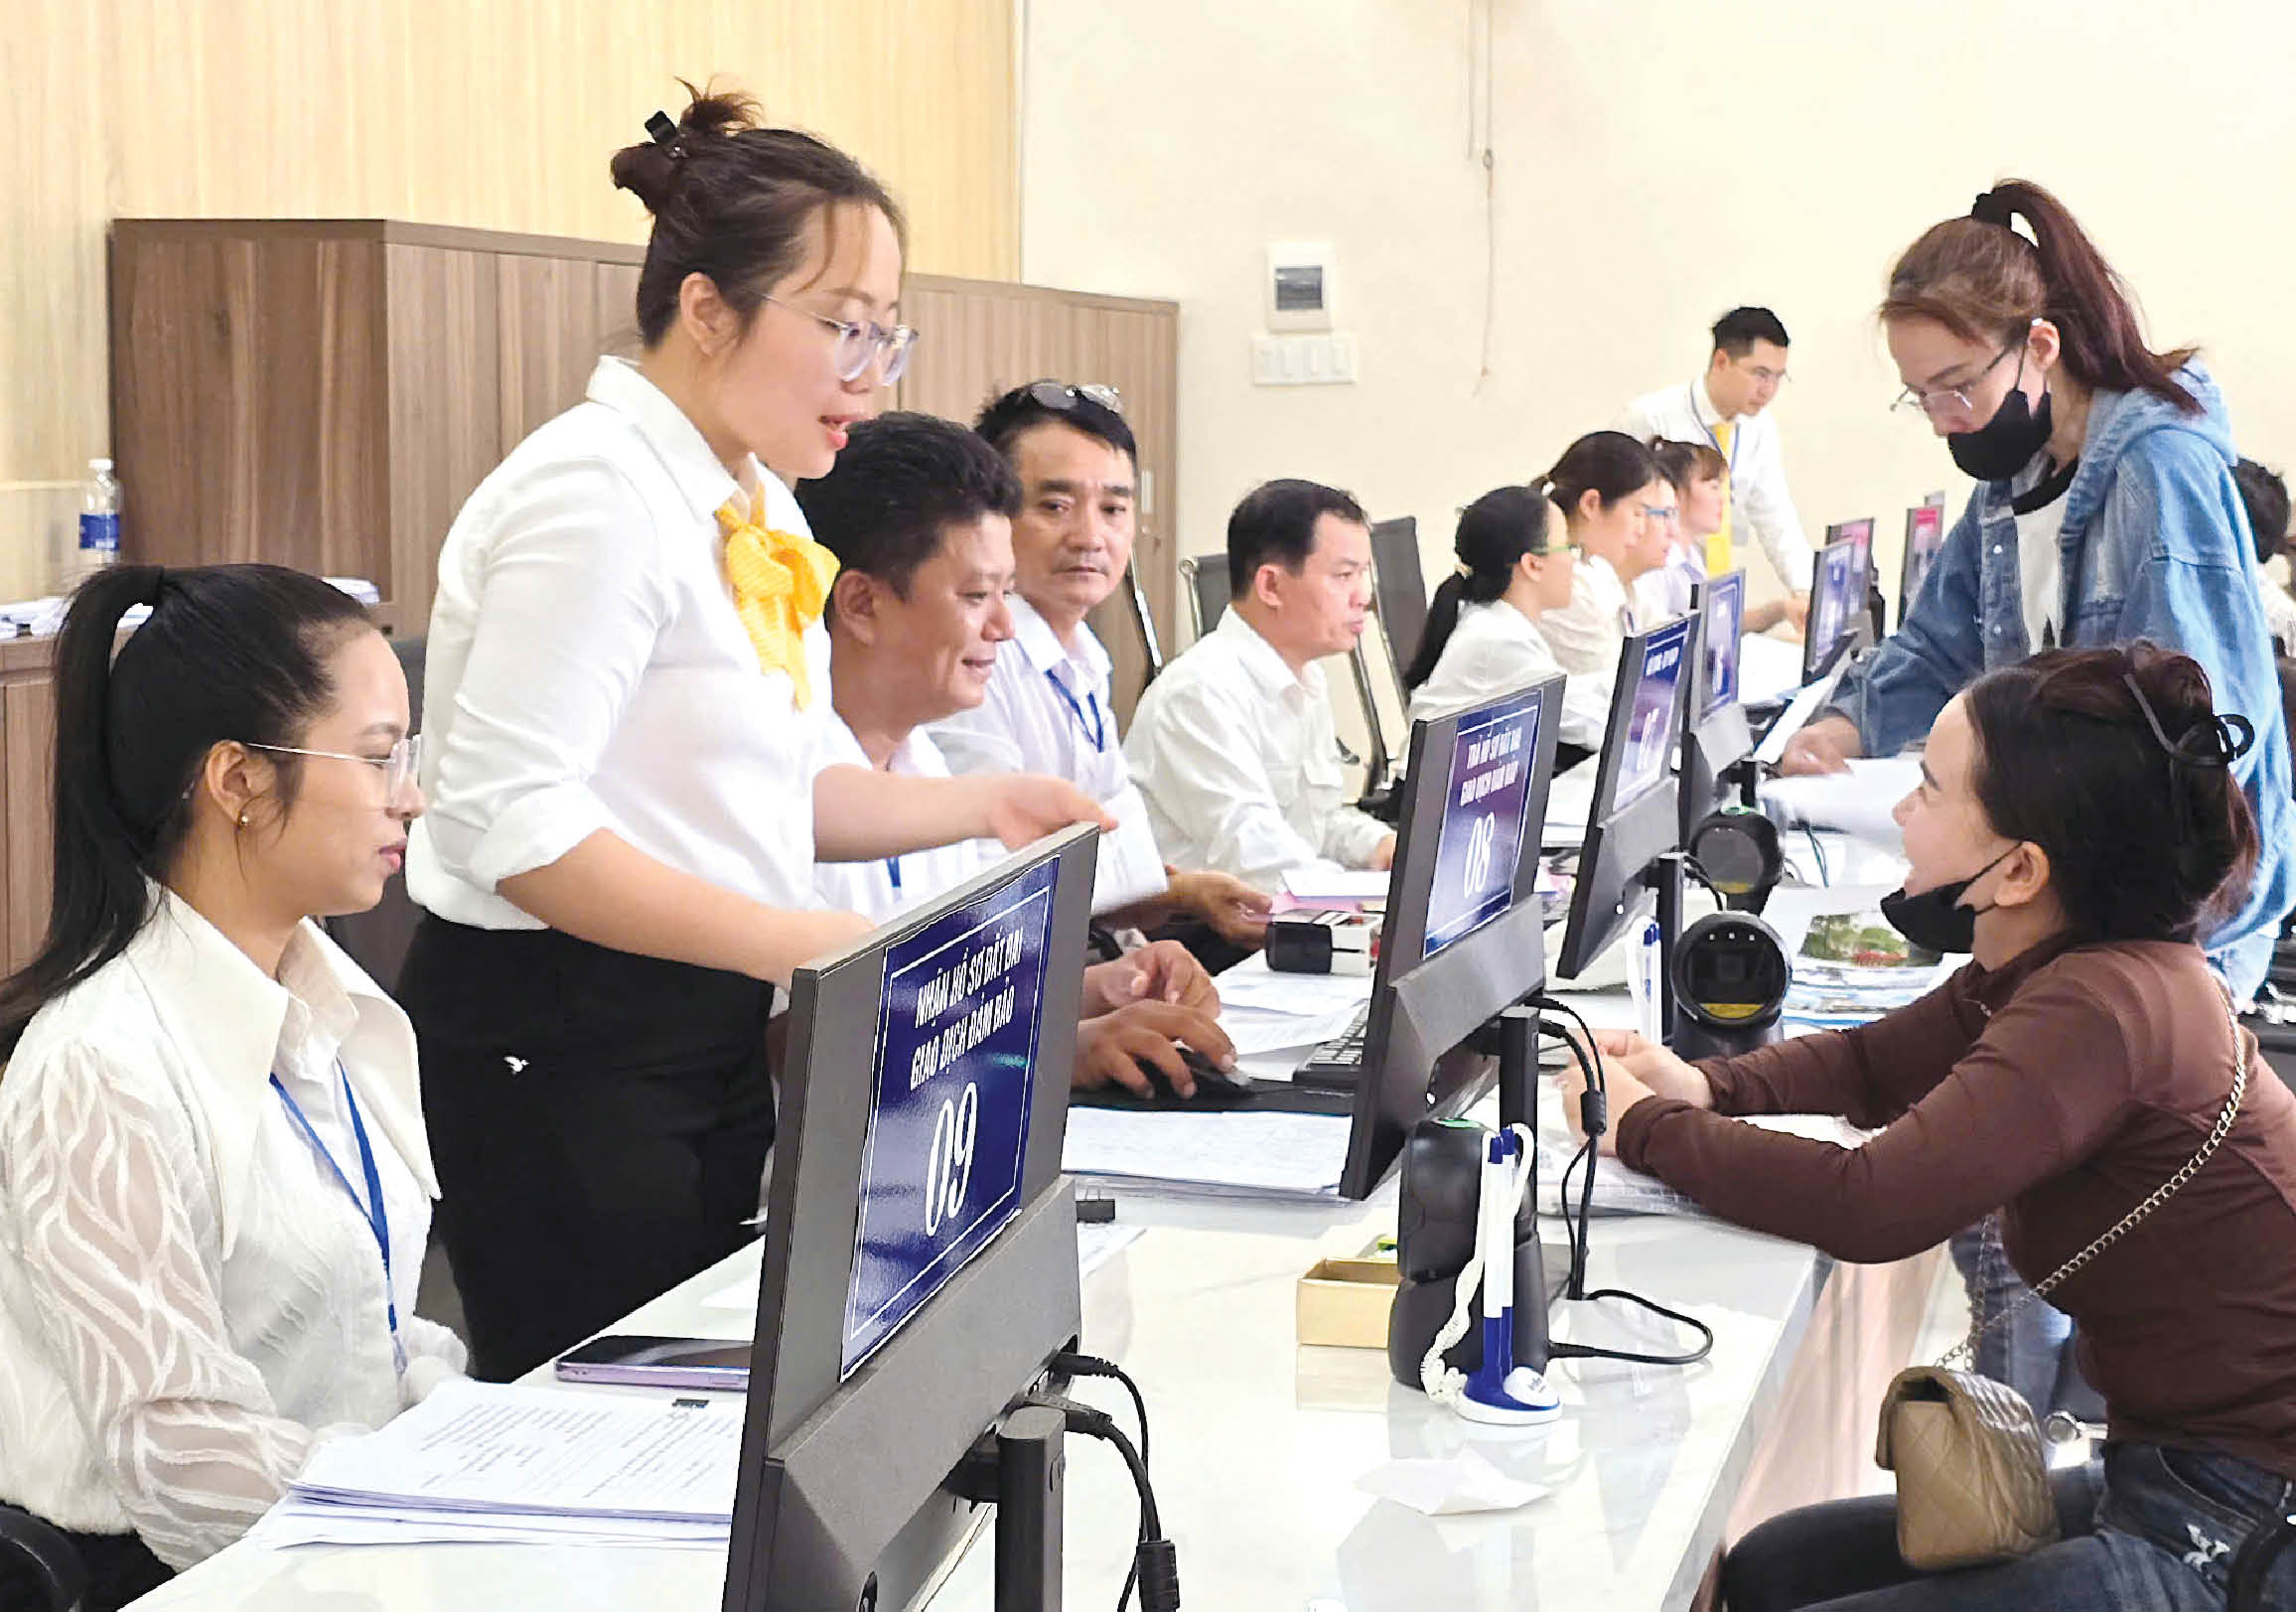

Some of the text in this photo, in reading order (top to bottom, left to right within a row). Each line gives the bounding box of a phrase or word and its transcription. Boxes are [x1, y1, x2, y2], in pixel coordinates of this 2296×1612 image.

[1464, 811, 1496, 898] 08
[915, 967, 951, 1029] NHẬN
[949, 947, 969, 1007] HỒ
[967, 947, 986, 996] SƠ
[983, 925, 1005, 985] ĐẤT
[910, 975, 1015, 1091] GIAO DỊCH ĐẢM BẢO
[926, 1082, 978, 1237] 09
